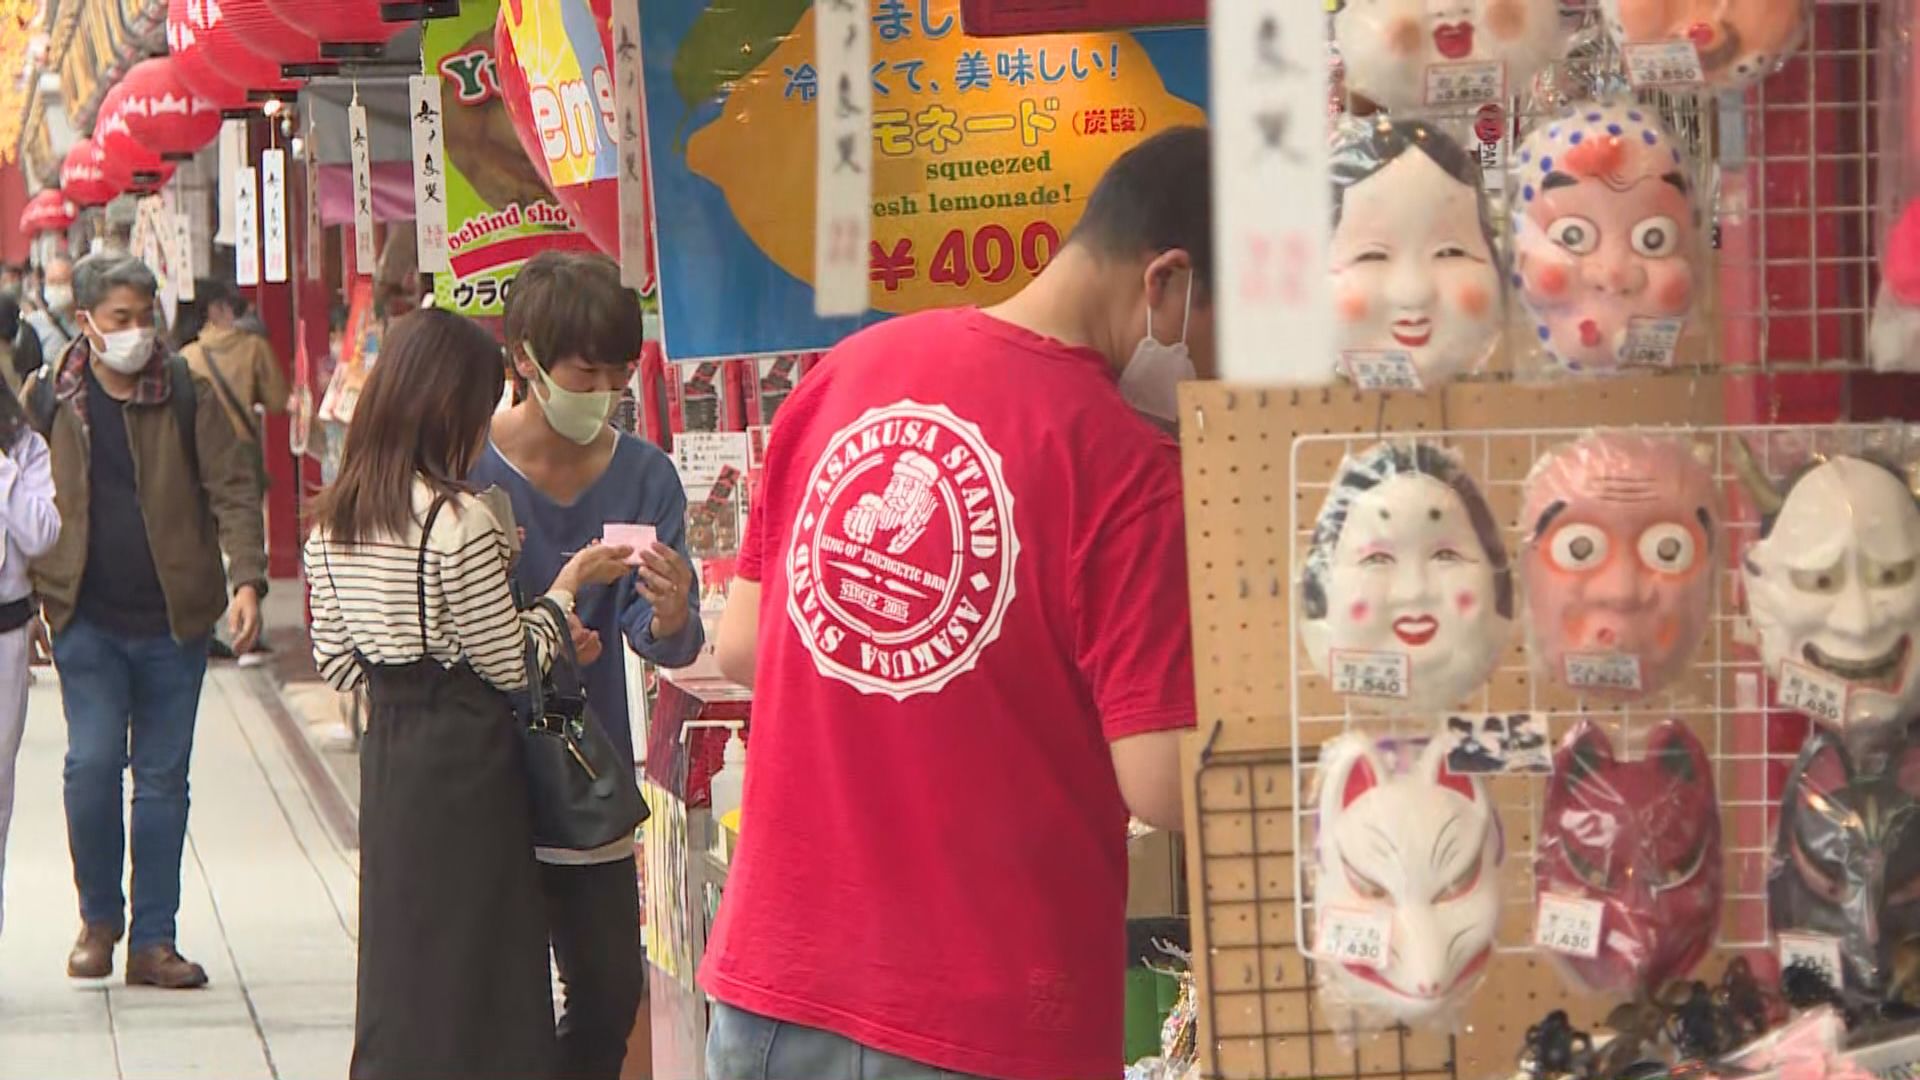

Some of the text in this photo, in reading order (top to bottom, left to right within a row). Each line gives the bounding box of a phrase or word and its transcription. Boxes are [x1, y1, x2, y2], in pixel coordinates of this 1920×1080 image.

[872, 0, 963, 39] まし
[784, 44, 1119, 101] 冷くて、美味しい!
[872, 99, 1060, 155] モネード
[926, 150, 1052, 181] squeezed
[871, 183, 1072, 218] esh lemonade!
[449, 206, 520, 250] behind
[816, 419, 940, 502] ASAKUSA
[940, 445, 998, 559] STAND
[794, 543, 983, 679] ASAKUSA STAND
